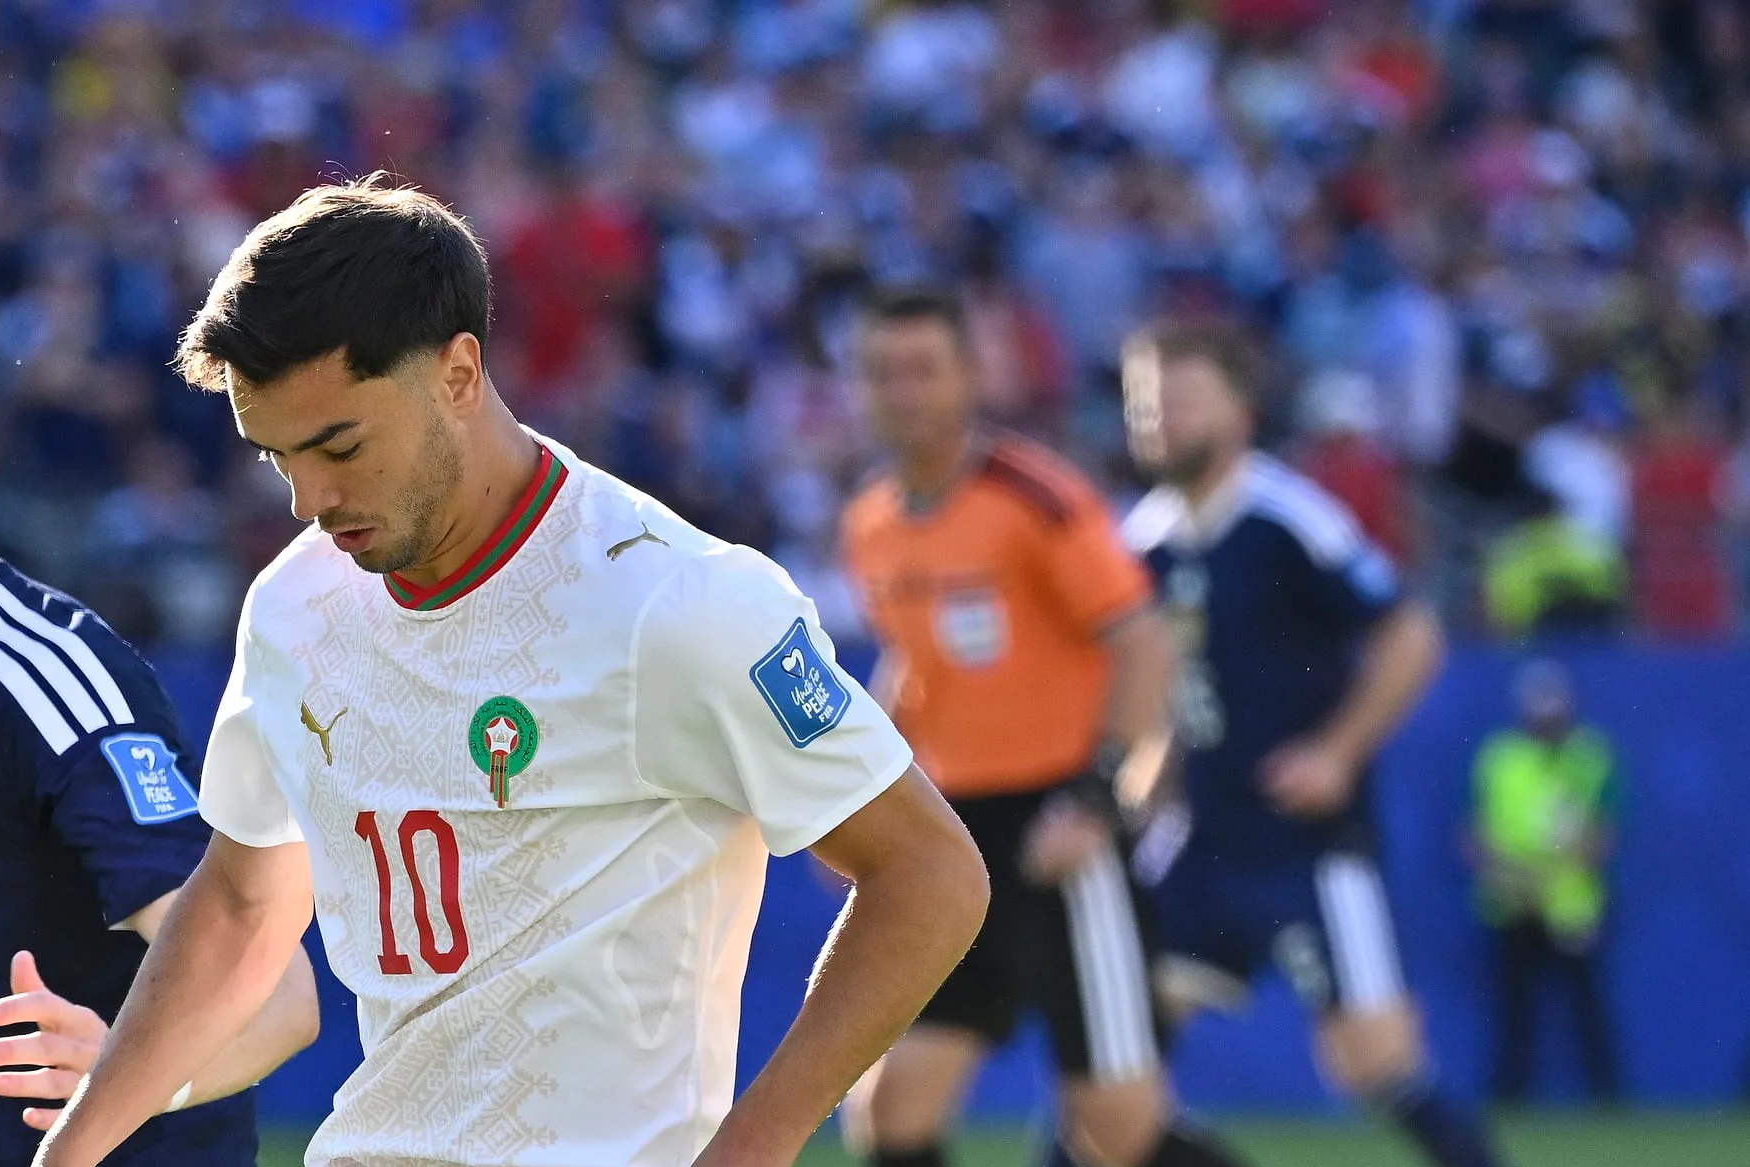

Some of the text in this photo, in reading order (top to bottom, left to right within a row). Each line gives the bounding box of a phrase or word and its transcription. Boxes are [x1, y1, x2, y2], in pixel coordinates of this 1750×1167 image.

[801, 682, 830, 719] PEACE
[818, 704, 835, 723] FIFA
[354, 810, 470, 975] 10
